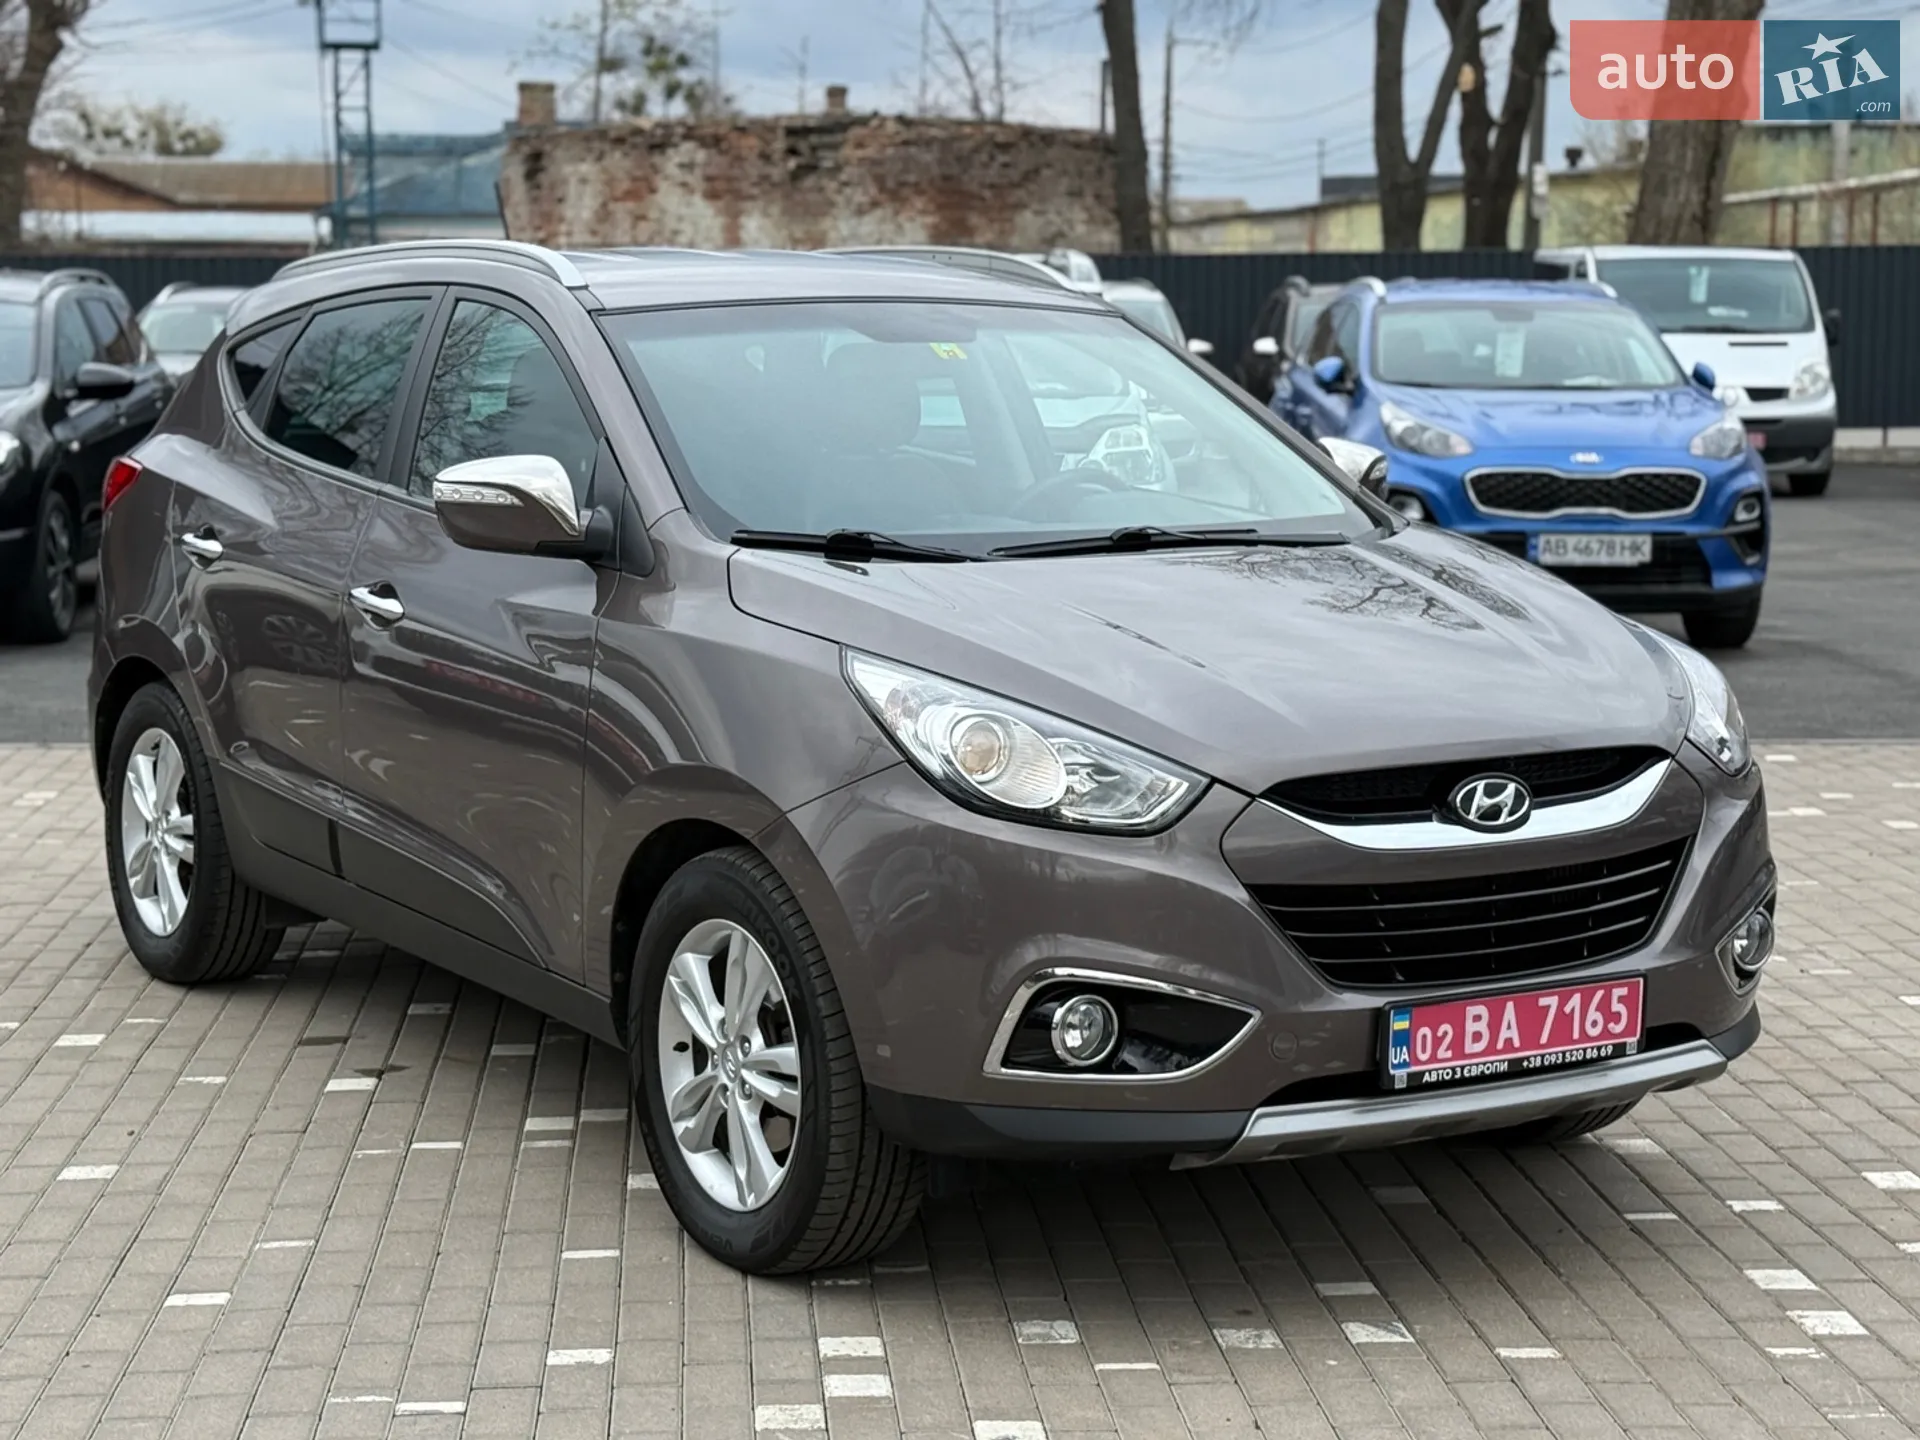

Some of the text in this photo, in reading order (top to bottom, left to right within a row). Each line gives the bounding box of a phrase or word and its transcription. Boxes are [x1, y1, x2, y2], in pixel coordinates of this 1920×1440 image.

[1541, 537, 1648, 557] AB 4678 HK
[1415, 986, 1629, 1062] 02 BA 7165
[1391, 1045, 1410, 1065] UA
[1422, 1068, 1453, 1083] АВТО
[1463, 1060, 1509, 1077] ЄВРОПИ
[1522, 1056, 1542, 1069] +38
[1543, 1052, 1563, 1066] 093
[1564, 1049, 1584, 1063] 520
[1600, 1044, 1614, 1057] 69
